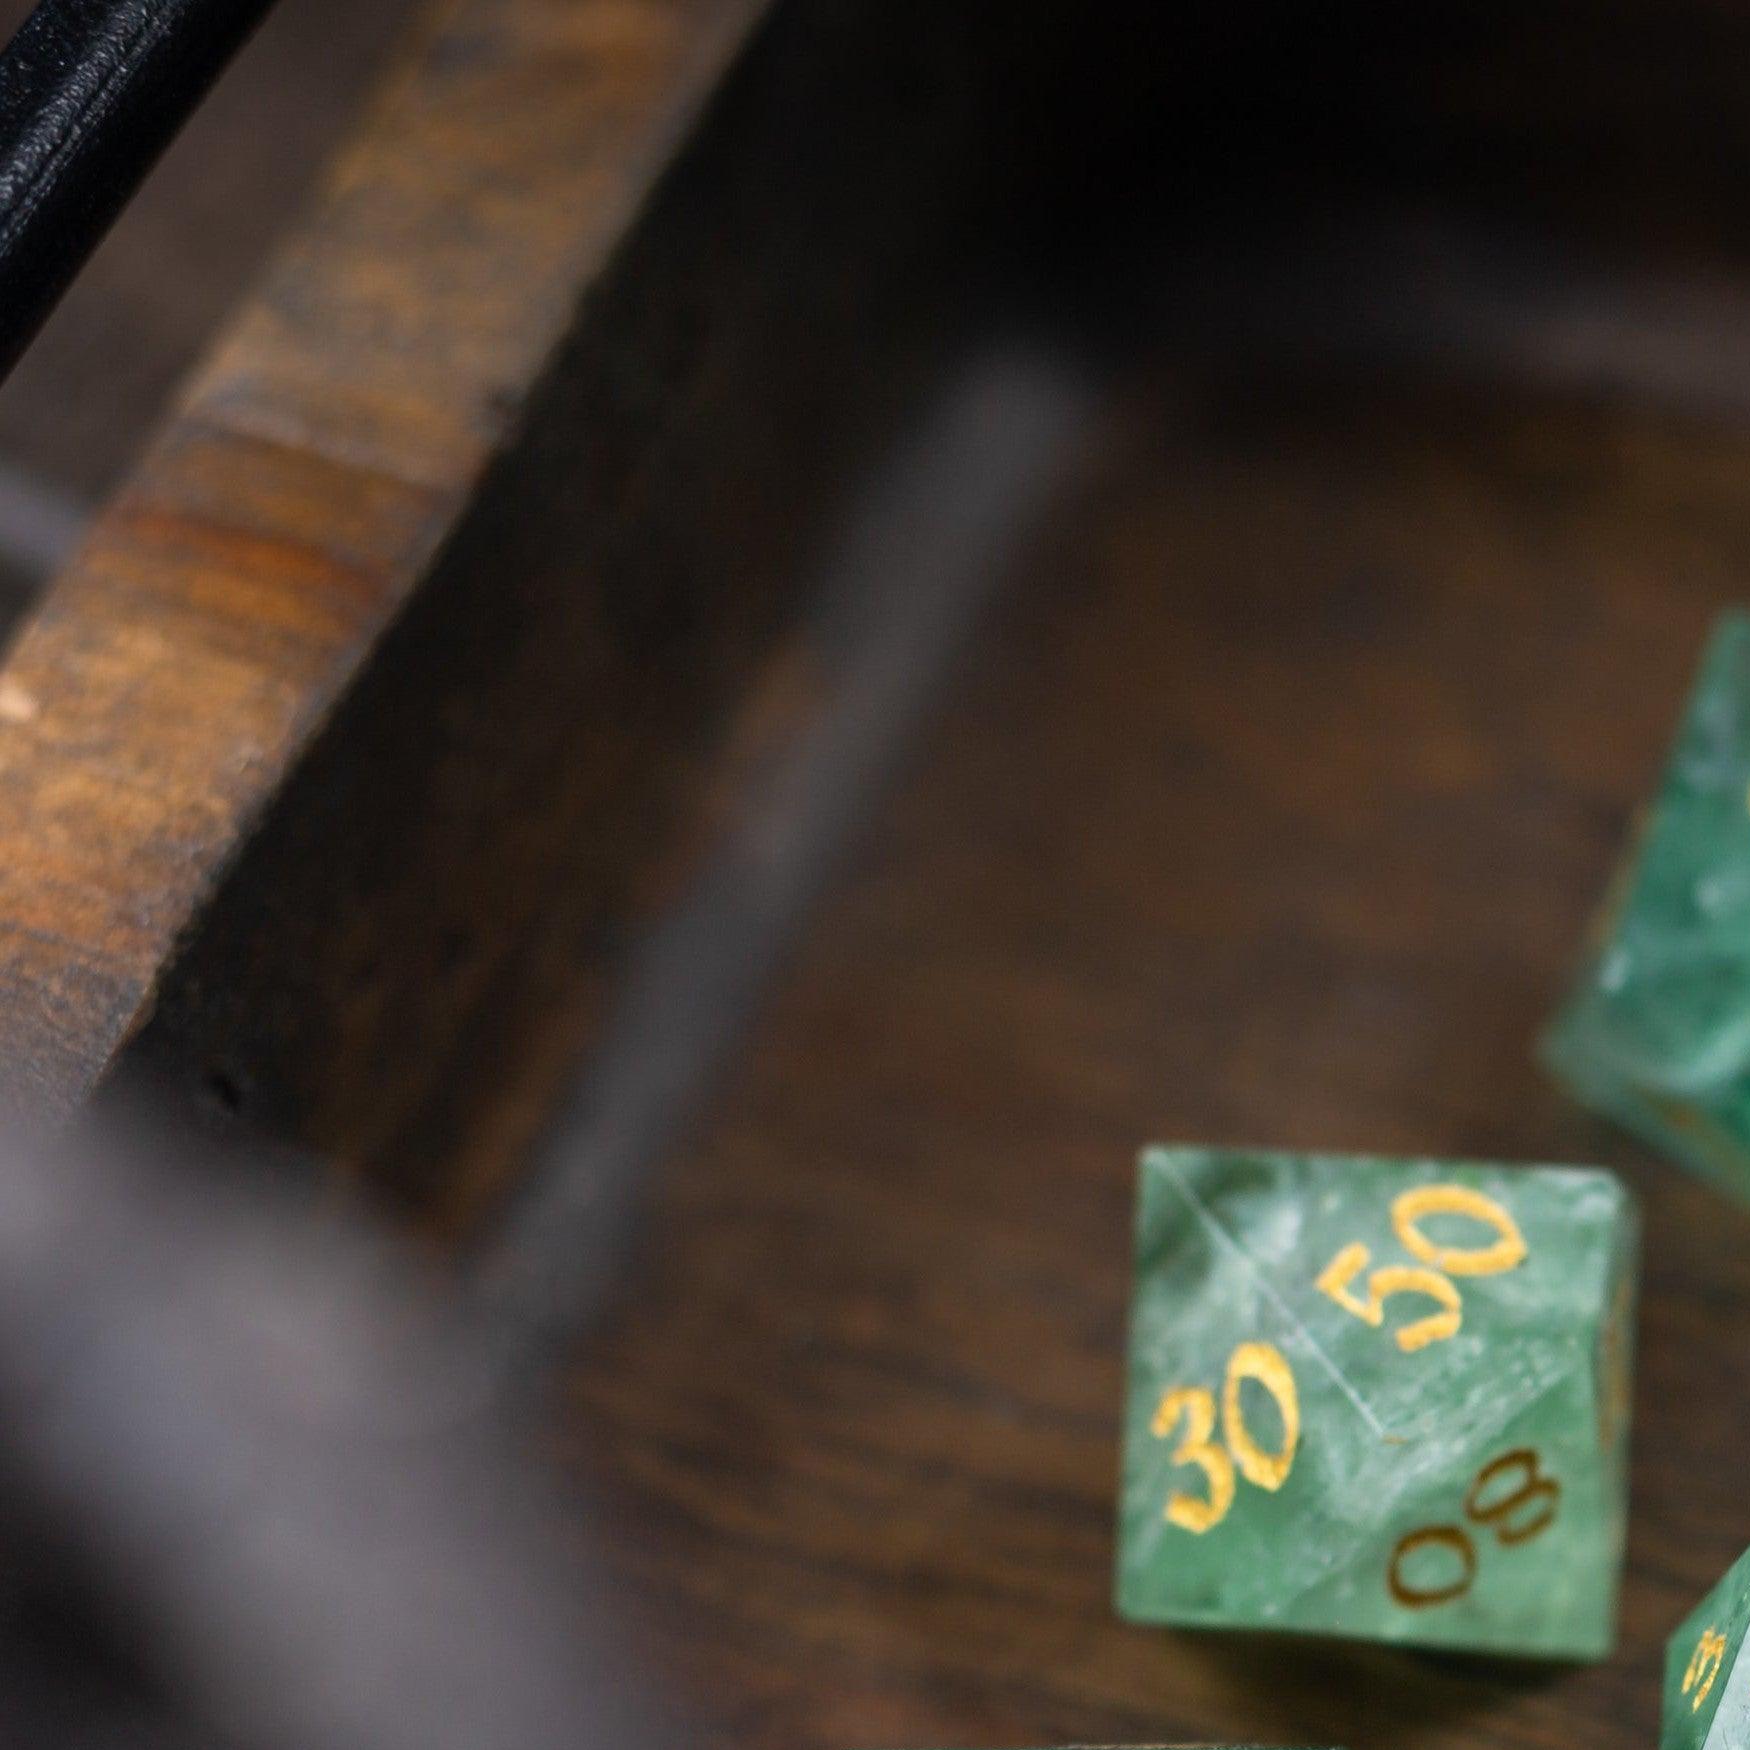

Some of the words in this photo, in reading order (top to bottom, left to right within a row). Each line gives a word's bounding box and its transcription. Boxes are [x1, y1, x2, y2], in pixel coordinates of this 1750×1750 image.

[1315, 1184, 1528, 1351] 50
[1151, 1342, 1298, 1533] 30
[1387, 1448, 1560, 1611] 80
